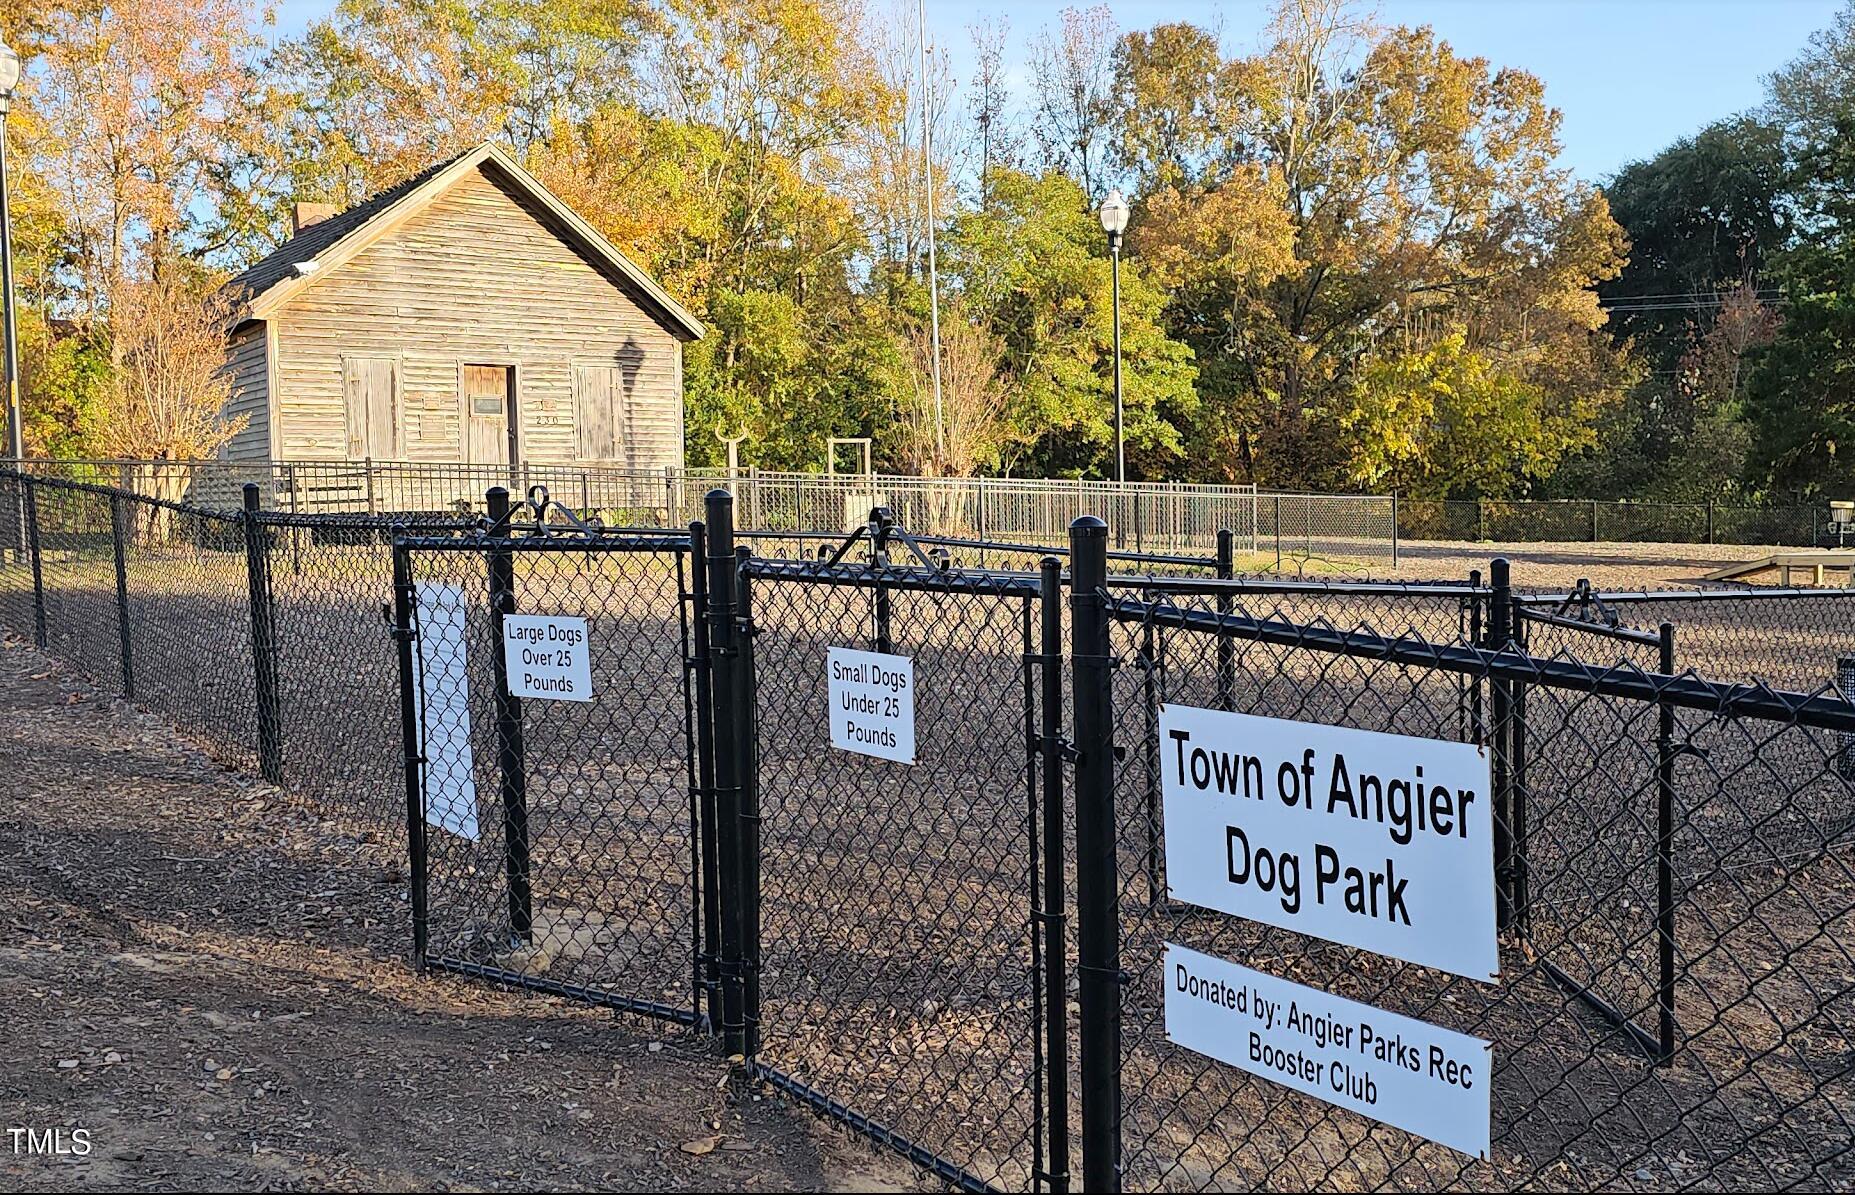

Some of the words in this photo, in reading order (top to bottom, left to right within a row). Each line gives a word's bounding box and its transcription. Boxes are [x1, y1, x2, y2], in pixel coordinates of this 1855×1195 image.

[536, 415, 559, 426] 230
[508, 623, 545, 644] Large
[548, 624, 583, 647] Dogs
[522, 648, 553, 667] Over
[556, 649, 572, 668] 25
[524, 672, 574, 693] Pounds
[833, 660, 868, 684] Small
[871, 664, 907, 693] Dogs
[841, 690, 881, 715] Under
[884, 696, 900, 719] 25
[847, 720, 897, 748] Pounds
[1169, 729, 1264, 801] Town
[1277, 748, 1315, 810] of
[1326, 753, 1475, 846] Angier
[1225, 825, 1301, 915] Dog
[1314, 843, 1412, 927] Park
[1176, 963, 1248, 1015] Donated
[1253, 988, 1282, 1031] by:
[1286, 1000, 1354, 1050] Angier
[1360, 1022, 1421, 1073] Parks
[1429, 1044, 1473, 1090] Rec
[1249, 1031, 1324, 1086] Booster
[1330, 1060, 1378, 1105] Club
